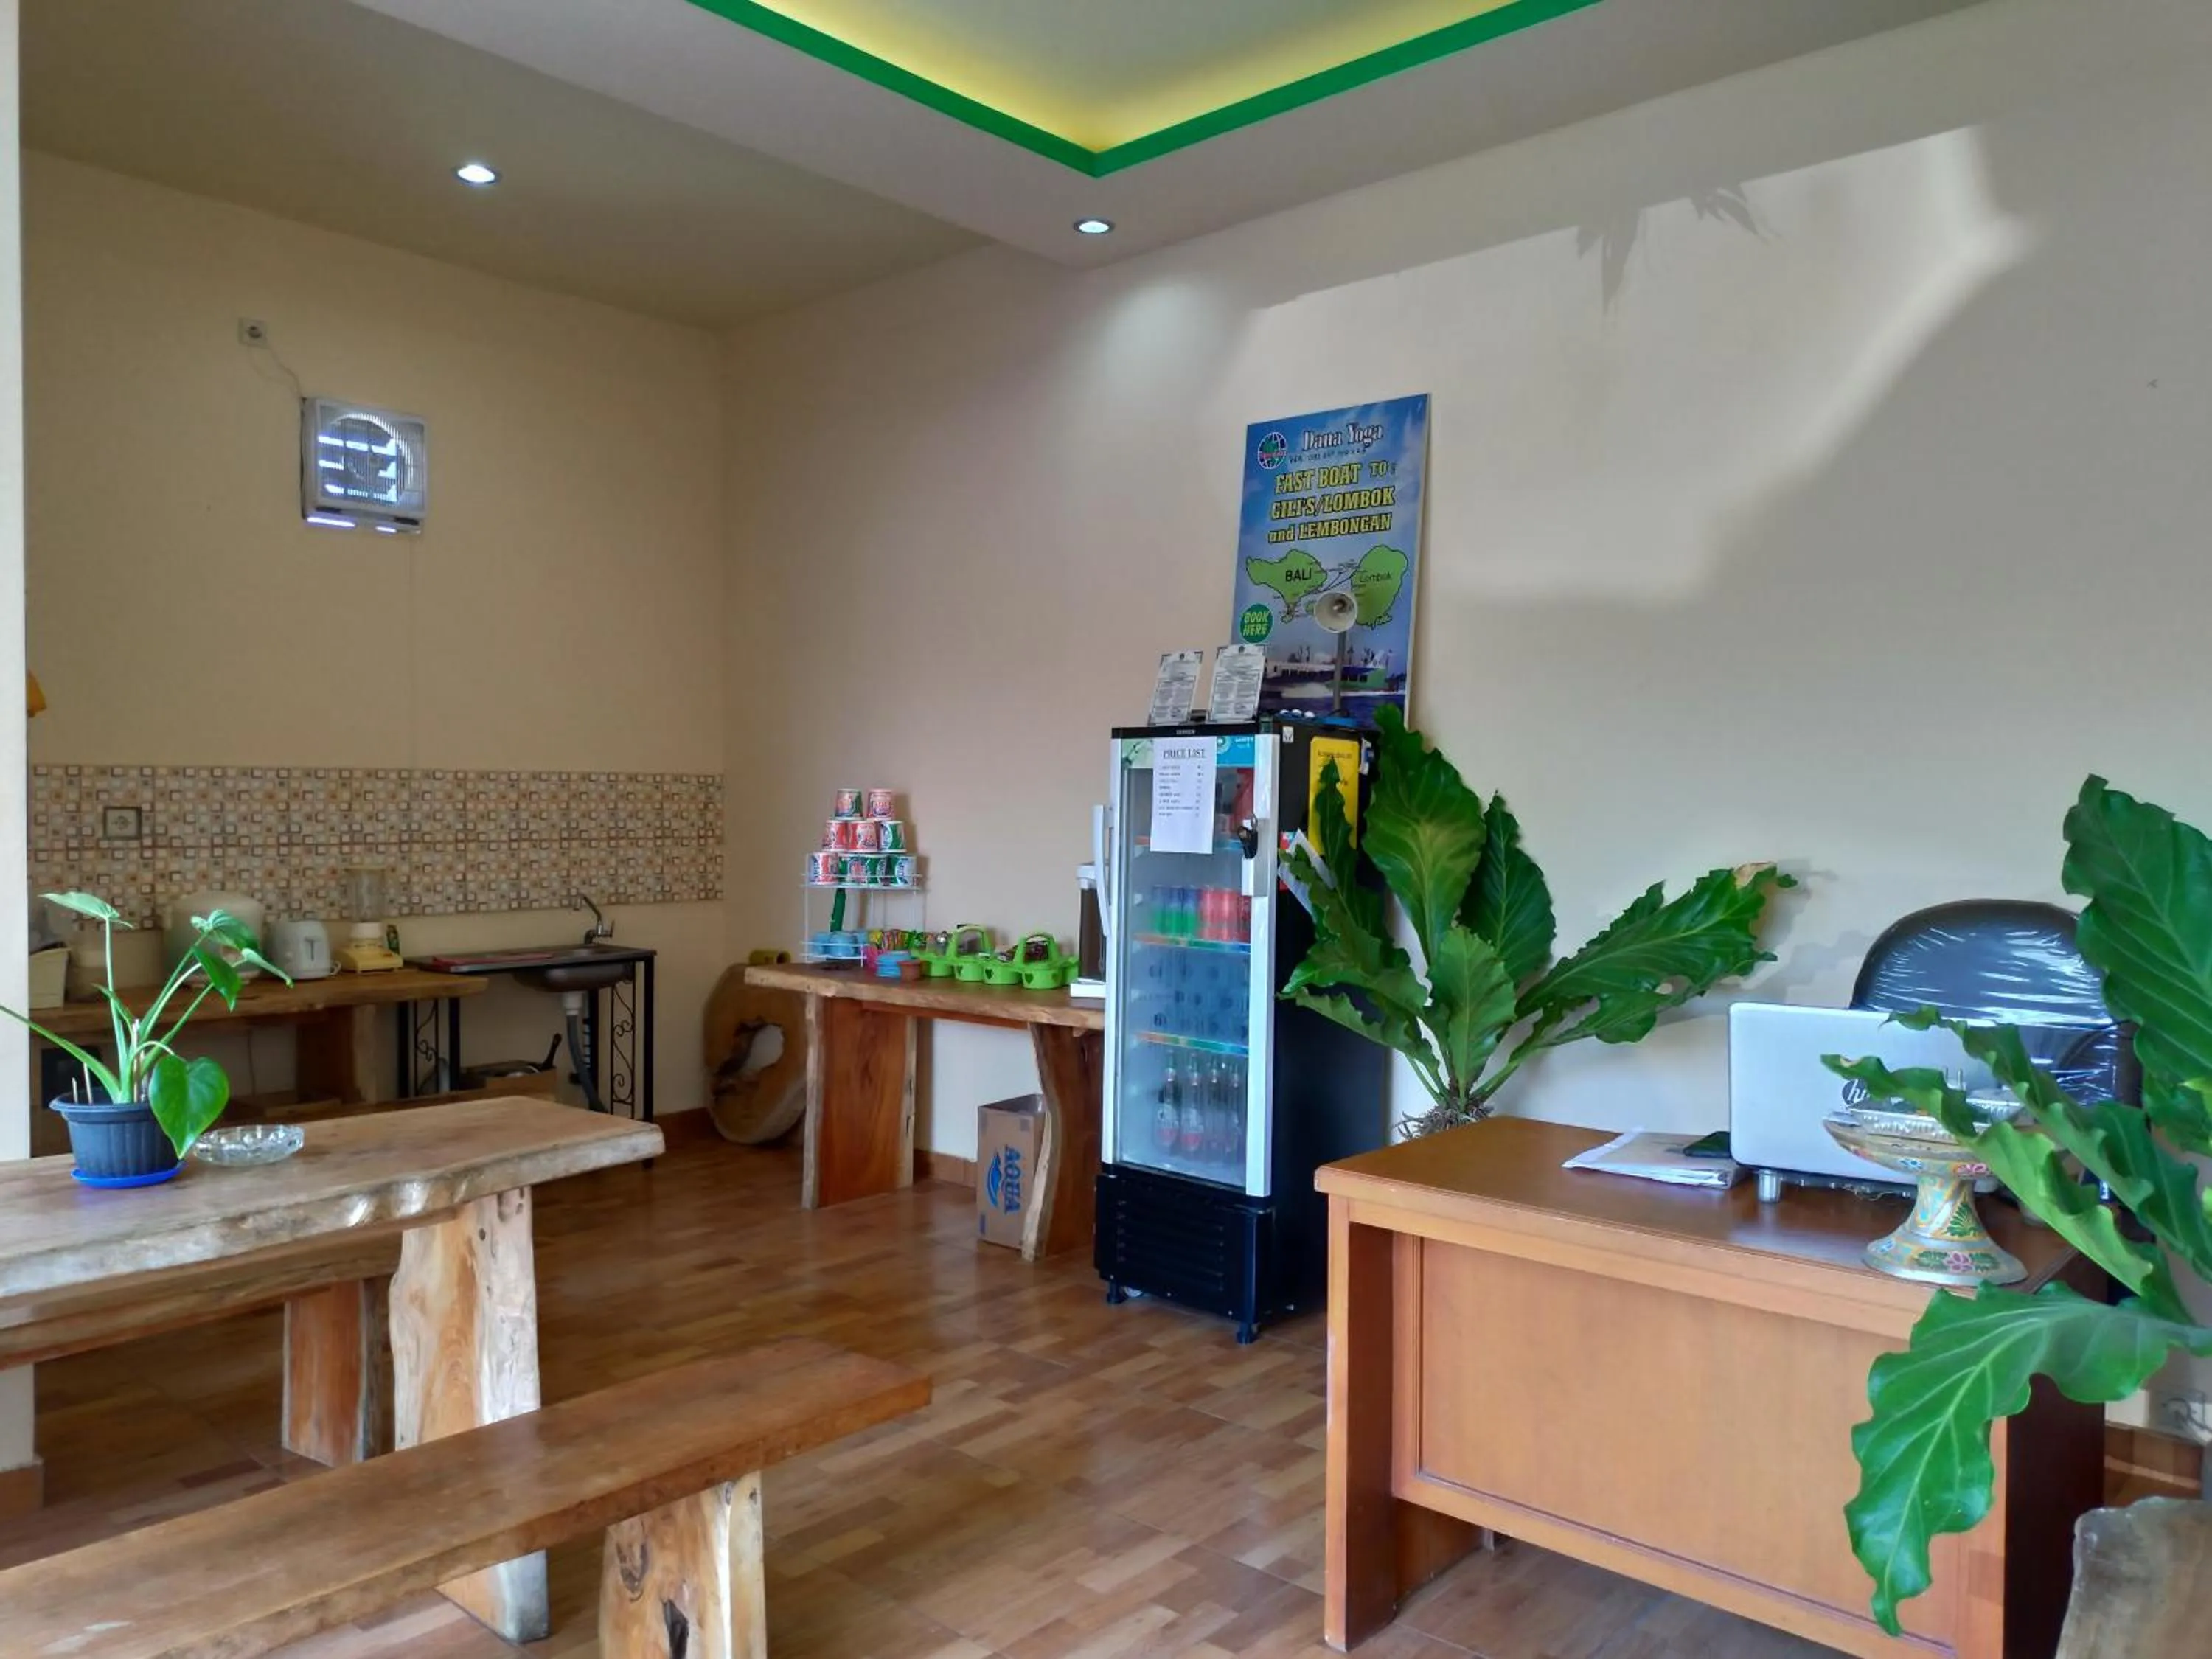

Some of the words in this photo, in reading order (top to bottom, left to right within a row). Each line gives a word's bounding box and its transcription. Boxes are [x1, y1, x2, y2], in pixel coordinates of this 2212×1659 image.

[1302, 430, 1343, 451] Dana
[1346, 422, 1384, 448] Yoga
[1317, 462, 1363, 489] BOAT
[1368, 460, 1388, 478] TO
[1268, 524, 1295, 544] and
[1298, 512, 1392, 540] LEMBONGAN
[1285, 568, 1312, 582] BALI
[1244, 611, 1269, 624] BOOK
[1242, 623, 1268, 636] HERE
[1163, 748, 1186, 759] PRICE
[1188, 748, 1206, 759] LIST
[1002, 1144, 1021, 1215] AQUA
